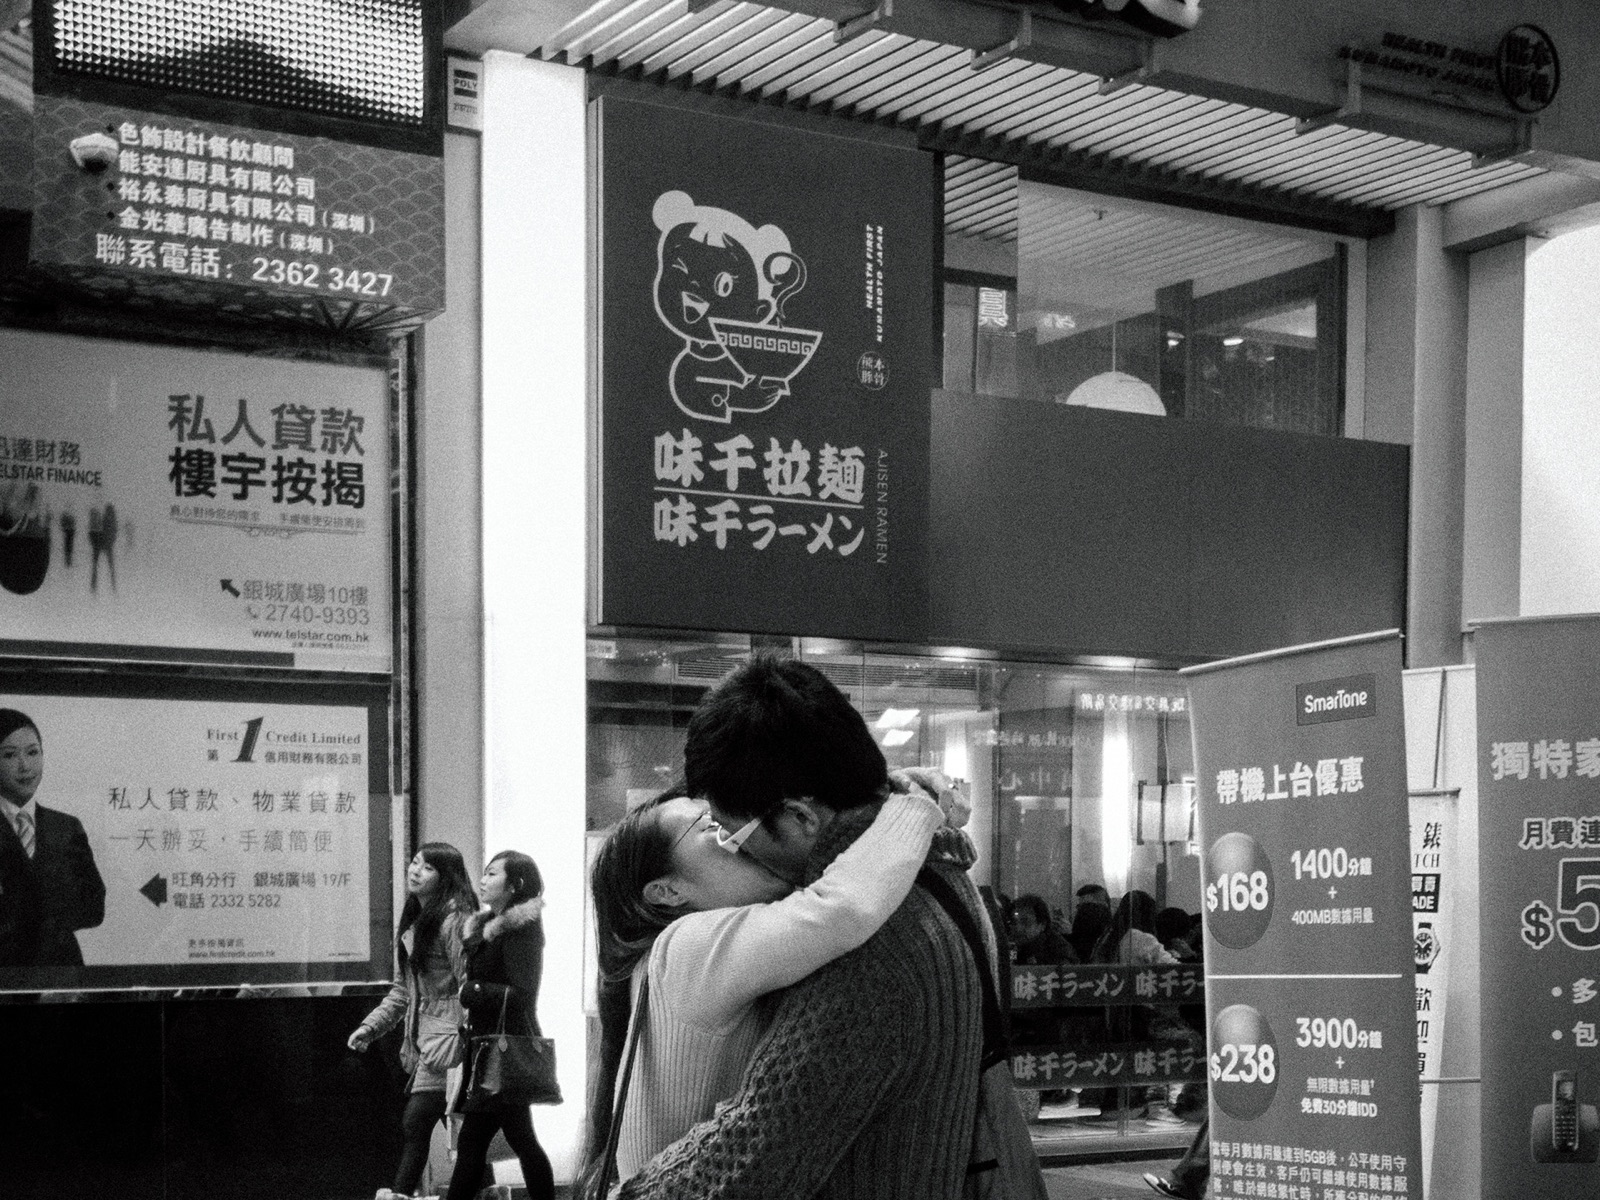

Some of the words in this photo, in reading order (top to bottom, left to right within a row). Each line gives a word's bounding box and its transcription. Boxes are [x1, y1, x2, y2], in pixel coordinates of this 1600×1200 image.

[251, 257, 320, 289] 2362
[329, 267, 394, 297] 3427
[167, 393, 366, 457] 私人貸款
[47, 467, 102, 487] FINANCE
[168, 446, 366, 509] 樓宇按揭
[877, 449, 888, 502] AJISEN
[653, 494, 866, 557] 味千ラーメン
[877, 506, 888, 564] RAMEN
[265, 604, 370, 625] 2740-9393
[252, 629, 370, 643] www.telstar.com.hk
[1304, 689, 1368, 714] SmarTone
[206, 728, 239, 742] First
[265, 731, 308, 744] Credit
[311, 731, 361, 745] Limited
[264, 751, 362, 765] 信用財務有限公司
[1216, 756, 1365, 805] 帶機上台優惠
[172, 872, 236, 888] 旺角分行
[254, 872, 316, 889] 銀城廣場
[323, 872, 352, 887] 19/F
[1206, 871, 1269, 912] $168
[172, 893, 205, 909] 電話
[211, 894, 245, 908] 2332
[248, 894, 281, 908] 5282
[1013, 971, 1125, 1000] 味千ラーメン
[1572, 978, 1598, 1004] 多
[1572, 1021, 1598, 1047] 包
[1013, 1052, 1125, 1080] 味千ラーメン
[1210, 1044, 1276, 1084] $238
